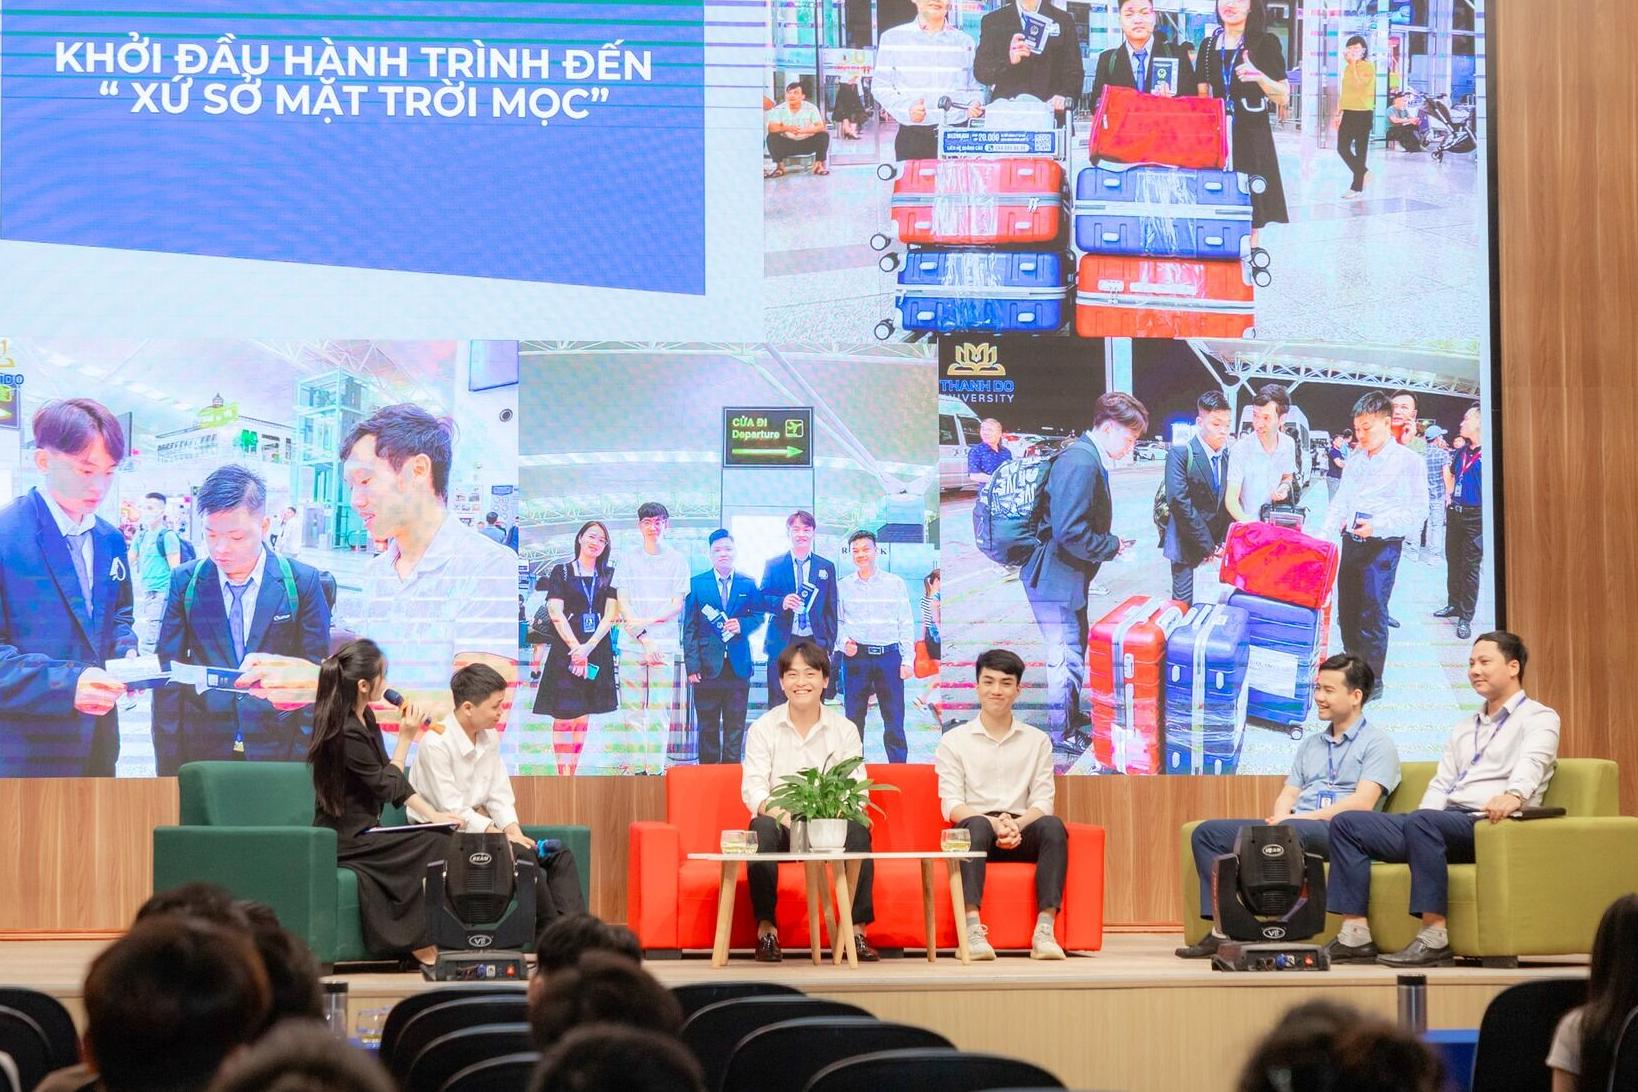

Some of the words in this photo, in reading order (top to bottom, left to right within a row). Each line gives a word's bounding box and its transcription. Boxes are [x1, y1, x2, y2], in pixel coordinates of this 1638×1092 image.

[56, 32, 161, 73] KHỞI
[174, 33, 270, 75] ĐẦU
[285, 37, 408, 77] HÀNH
[420, 39, 549, 79] TRÌNH
[562, 39, 652, 81] ĐẾN
[130, 74, 194, 114] XỨ
[203, 73, 263, 115] SỞ
[275, 76, 369, 124] MẶT
[377, 79, 477, 117] TRỜI
[940, 379, 991, 392] THANH
[993, 379, 1015, 393] DO
[732, 430, 780, 441] Departure
